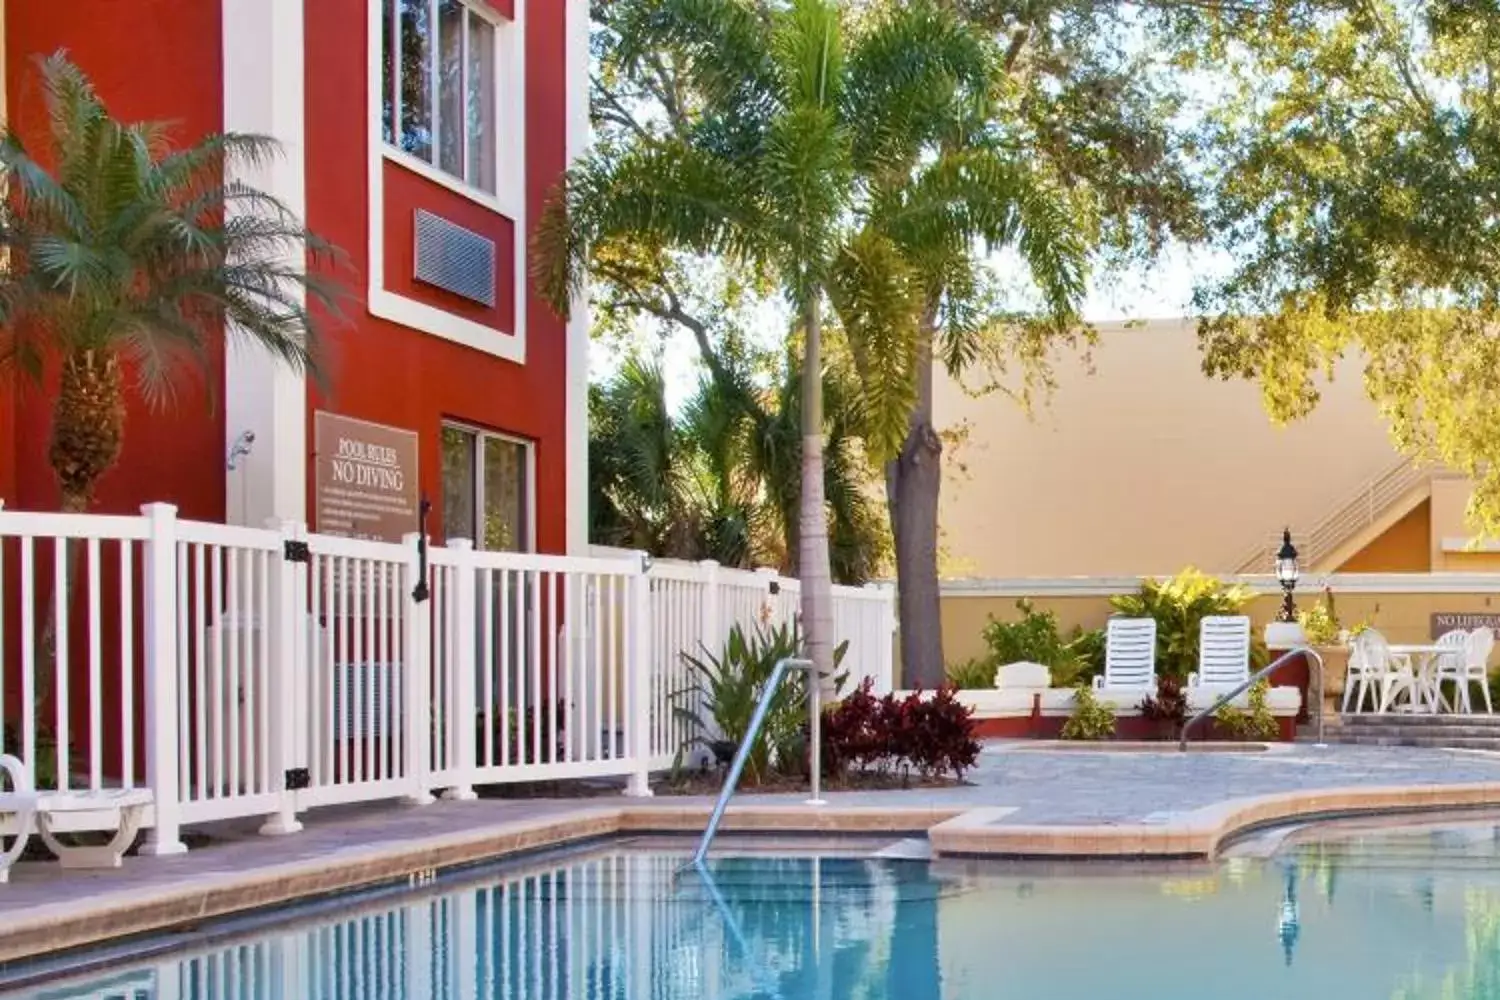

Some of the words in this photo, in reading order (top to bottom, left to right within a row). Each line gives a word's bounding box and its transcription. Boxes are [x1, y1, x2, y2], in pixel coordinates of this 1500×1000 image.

[339, 437, 366, 460] POOL
[368, 443, 397, 465] RULES
[332, 461, 353, 482] NO
[357, 465, 403, 491] DIVING
[1436, 615, 1455, 626] NO
